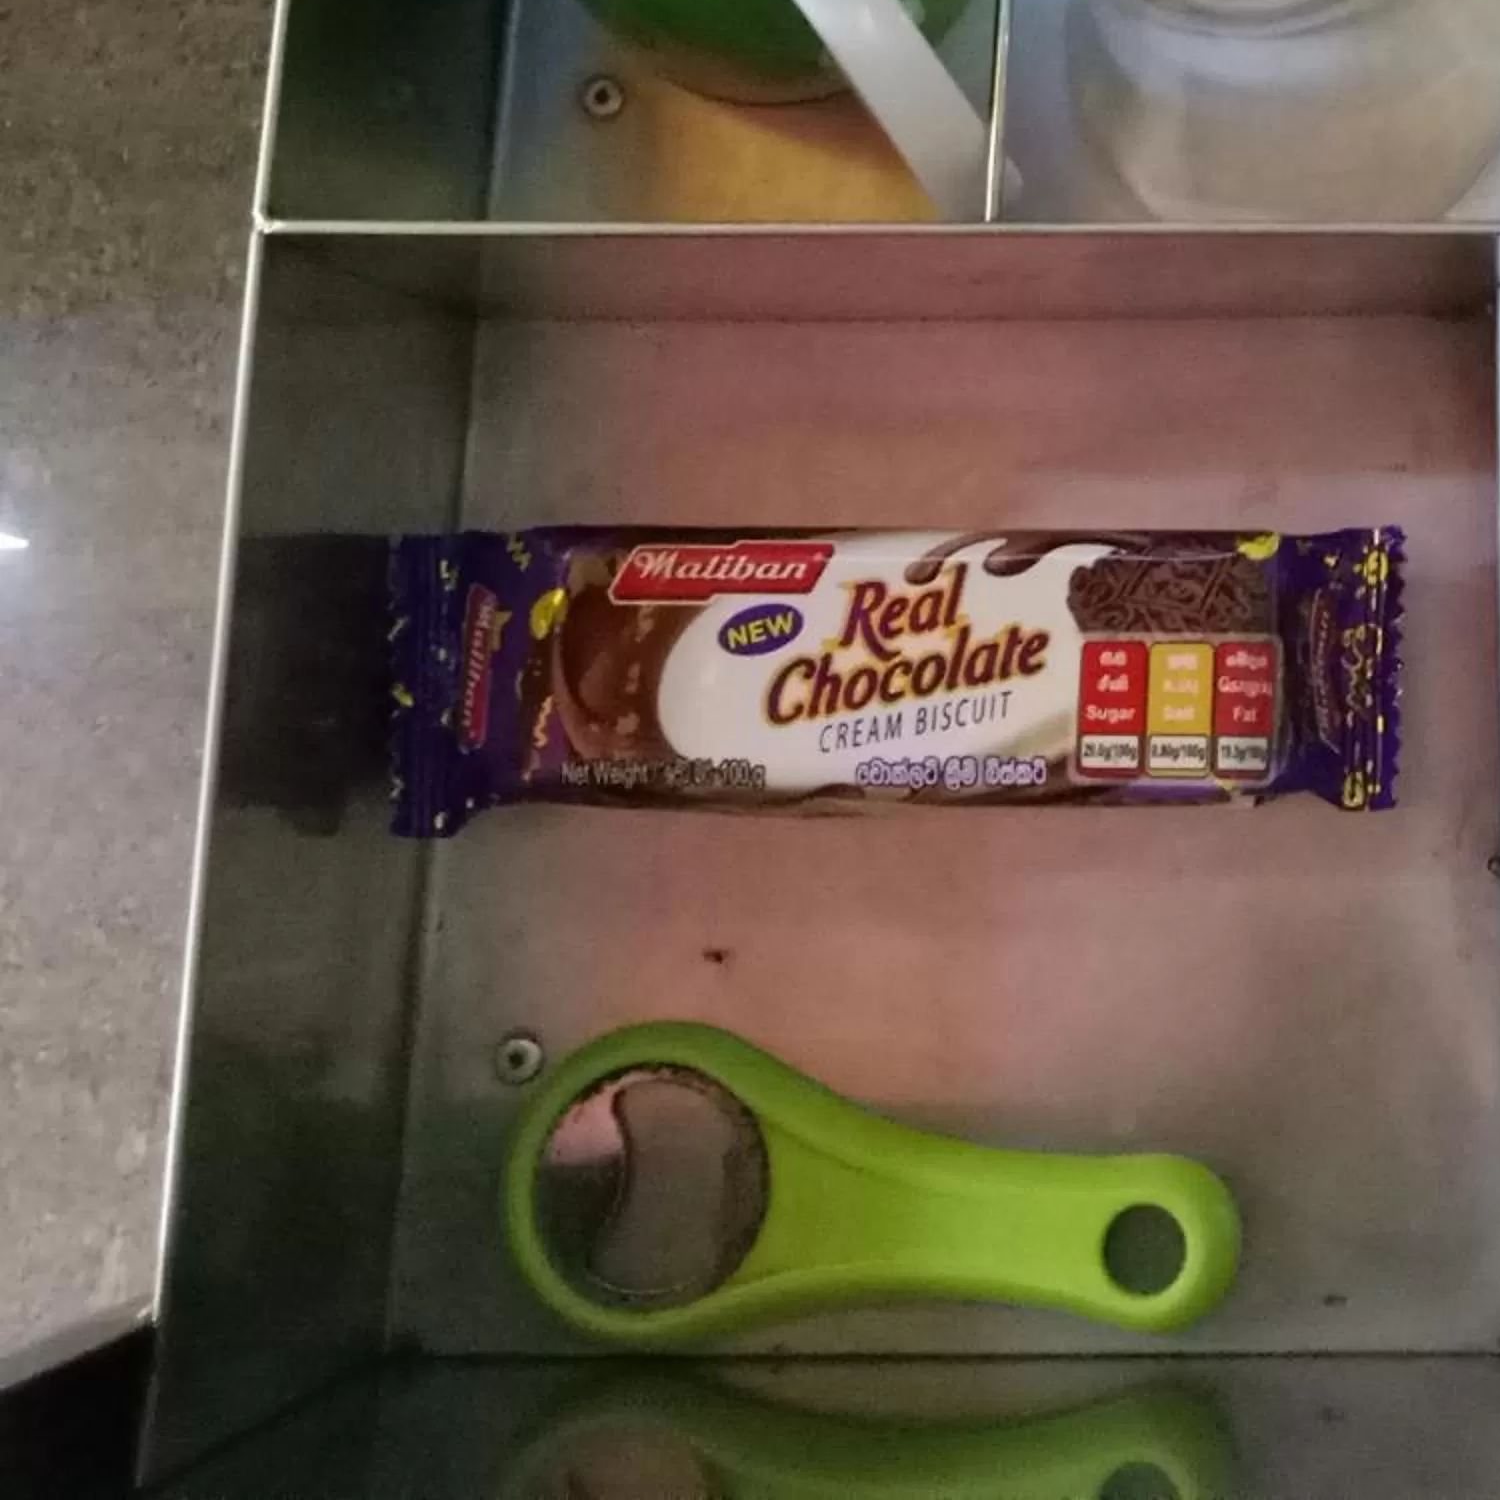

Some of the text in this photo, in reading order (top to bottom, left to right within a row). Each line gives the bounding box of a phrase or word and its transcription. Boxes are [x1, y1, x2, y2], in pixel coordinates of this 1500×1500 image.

[634, 551, 807, 581] Maliban
[727, 612, 796, 649] NEW
[838, 561, 968, 661] Real
[766, 624, 1049, 727] Chocolate
[819, 690, 1013, 753] CREAM BISCUIT
[1085, 704, 1136, 724] Sugar
